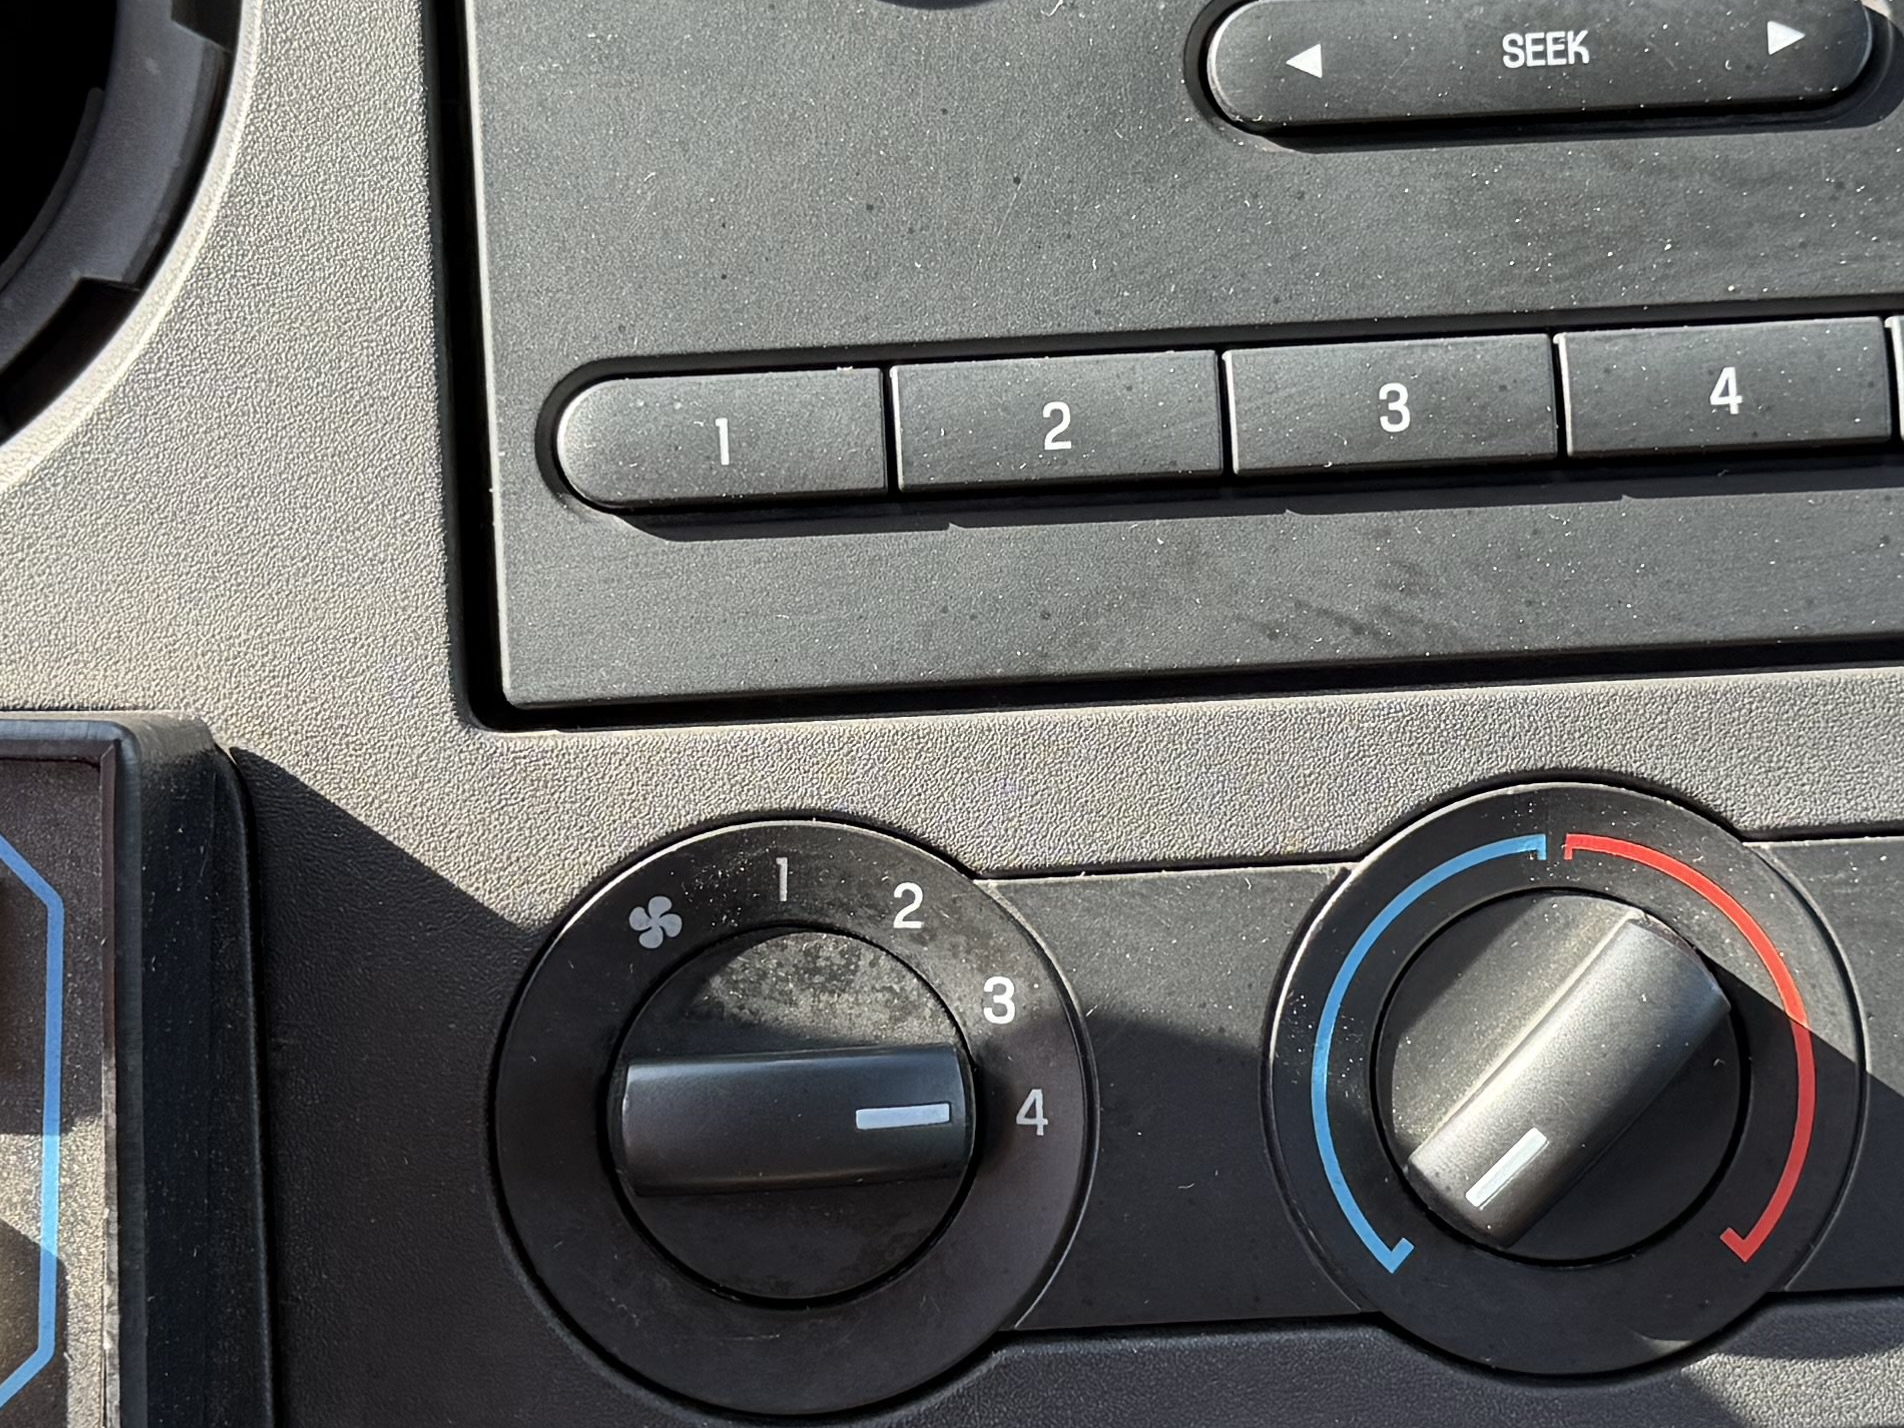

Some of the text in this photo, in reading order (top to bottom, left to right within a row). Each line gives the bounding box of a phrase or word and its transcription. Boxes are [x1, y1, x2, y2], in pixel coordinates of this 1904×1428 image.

[1503, 30, 1589, 68] SEEK
[1379, 383, 1410, 432] 3
[1710, 367, 1742, 414] 4
[716, 418, 729, 465] 1
[1043, 402, 1071, 450] 2
[777, 857, 788, 901] 1
[893, 883, 923, 928] 2
[984, 976, 1015, 1024] 3
[1017, 1089, 1048, 1135] 4
